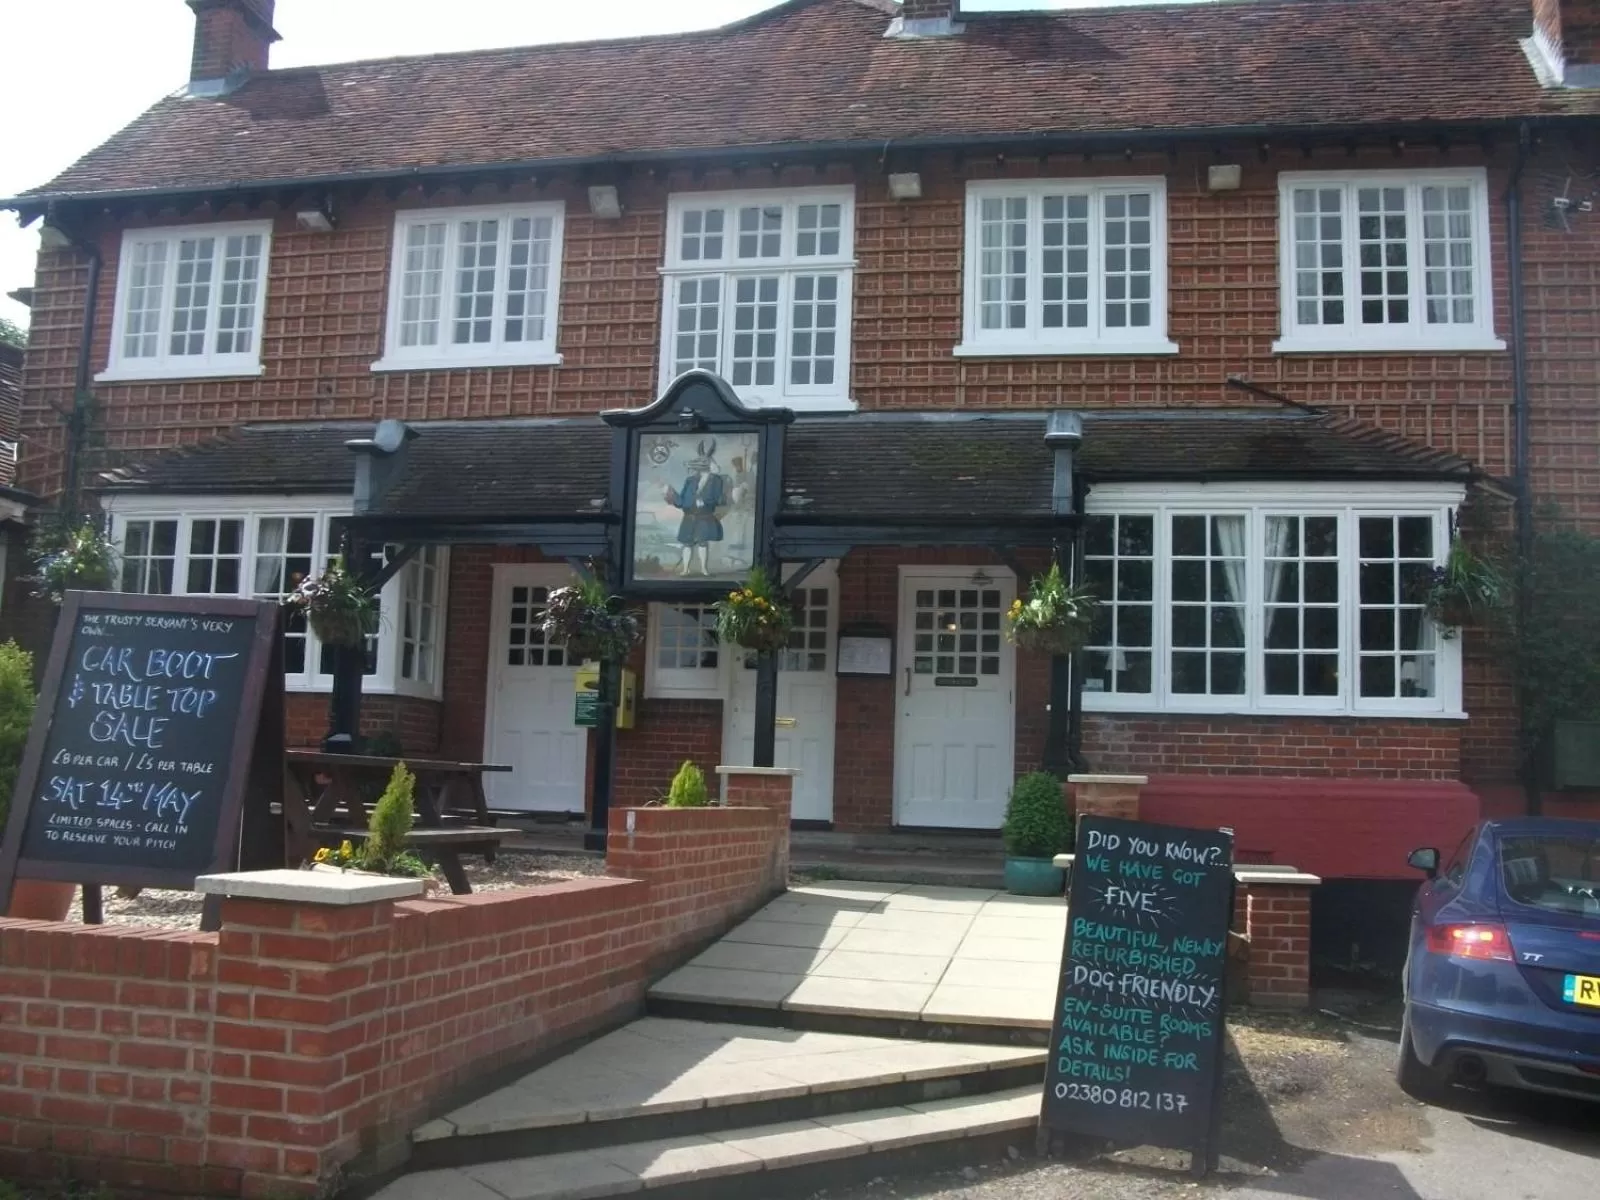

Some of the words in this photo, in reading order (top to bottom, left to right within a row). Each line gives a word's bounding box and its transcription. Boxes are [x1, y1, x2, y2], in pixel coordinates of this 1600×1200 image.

[82, 614, 100, 624] THE
[104, 614, 142, 626] TRUSTY
[144, 616, 198, 630] SERVANT'S
[202, 621, 233, 633] VERY
[82, 645, 142, 682] CAR
[146, 649, 238, 679] BOOT
[91, 682, 163, 711] TABLE
[167, 687, 217, 718] TOP
[89, 711, 170, 748] SALE
[73, 755, 93, 766] PER
[97, 755, 119, 767] CAR
[136, 753, 154, 770] £5
[158, 761, 175, 771] PER
[180, 761, 213, 774] TABLE
[41, 775, 95, 810] SAT
[143, 781, 202, 824] MAY
[45, 830, 58, 840] TO
[62, 831, 107, 844] RESERVE
[113, 836, 141, 847] YOUR
[146, 838, 176, 850] PITCH
[49, 813, 92, 827] LIMITED
[96, 817, 133, 830] SPACES
[145, 822, 169, 834] CALL
[175, 825, 188, 834] IN
[1088, 830, 1120, 850] DID
[1128, 837, 1159, 857] YOU
[1086, 854, 1111, 872] WE
[1119, 861, 1163, 880] HAVE
[1172, 869, 1206, 887] GOT
[1104, 886, 1161, 914] FIVE
[1073, 917, 1169, 953] BEAUTIFUL,
[1173, 936, 1224, 957] NEWLY
[1072, 939, 1196, 975] REFURBISHED
[1522, 952, 1544, 961] TT
[1074, 965, 1115, 992] DOG
[1118, 973, 1215, 1007] FRIENDLY
[1580, 979, 1600, 1000] R
[1064, 997, 1153, 1025] EN-SUITE
[1160, 1013, 1212, 1041] ROOMS
[1059, 1035, 1096, 1056] ASK
[1104, 1044, 1158, 1066] INSIDE
[1164, 1052, 1200, 1072] FOR
[1058, 1057, 1131, 1084] DETAILS!
